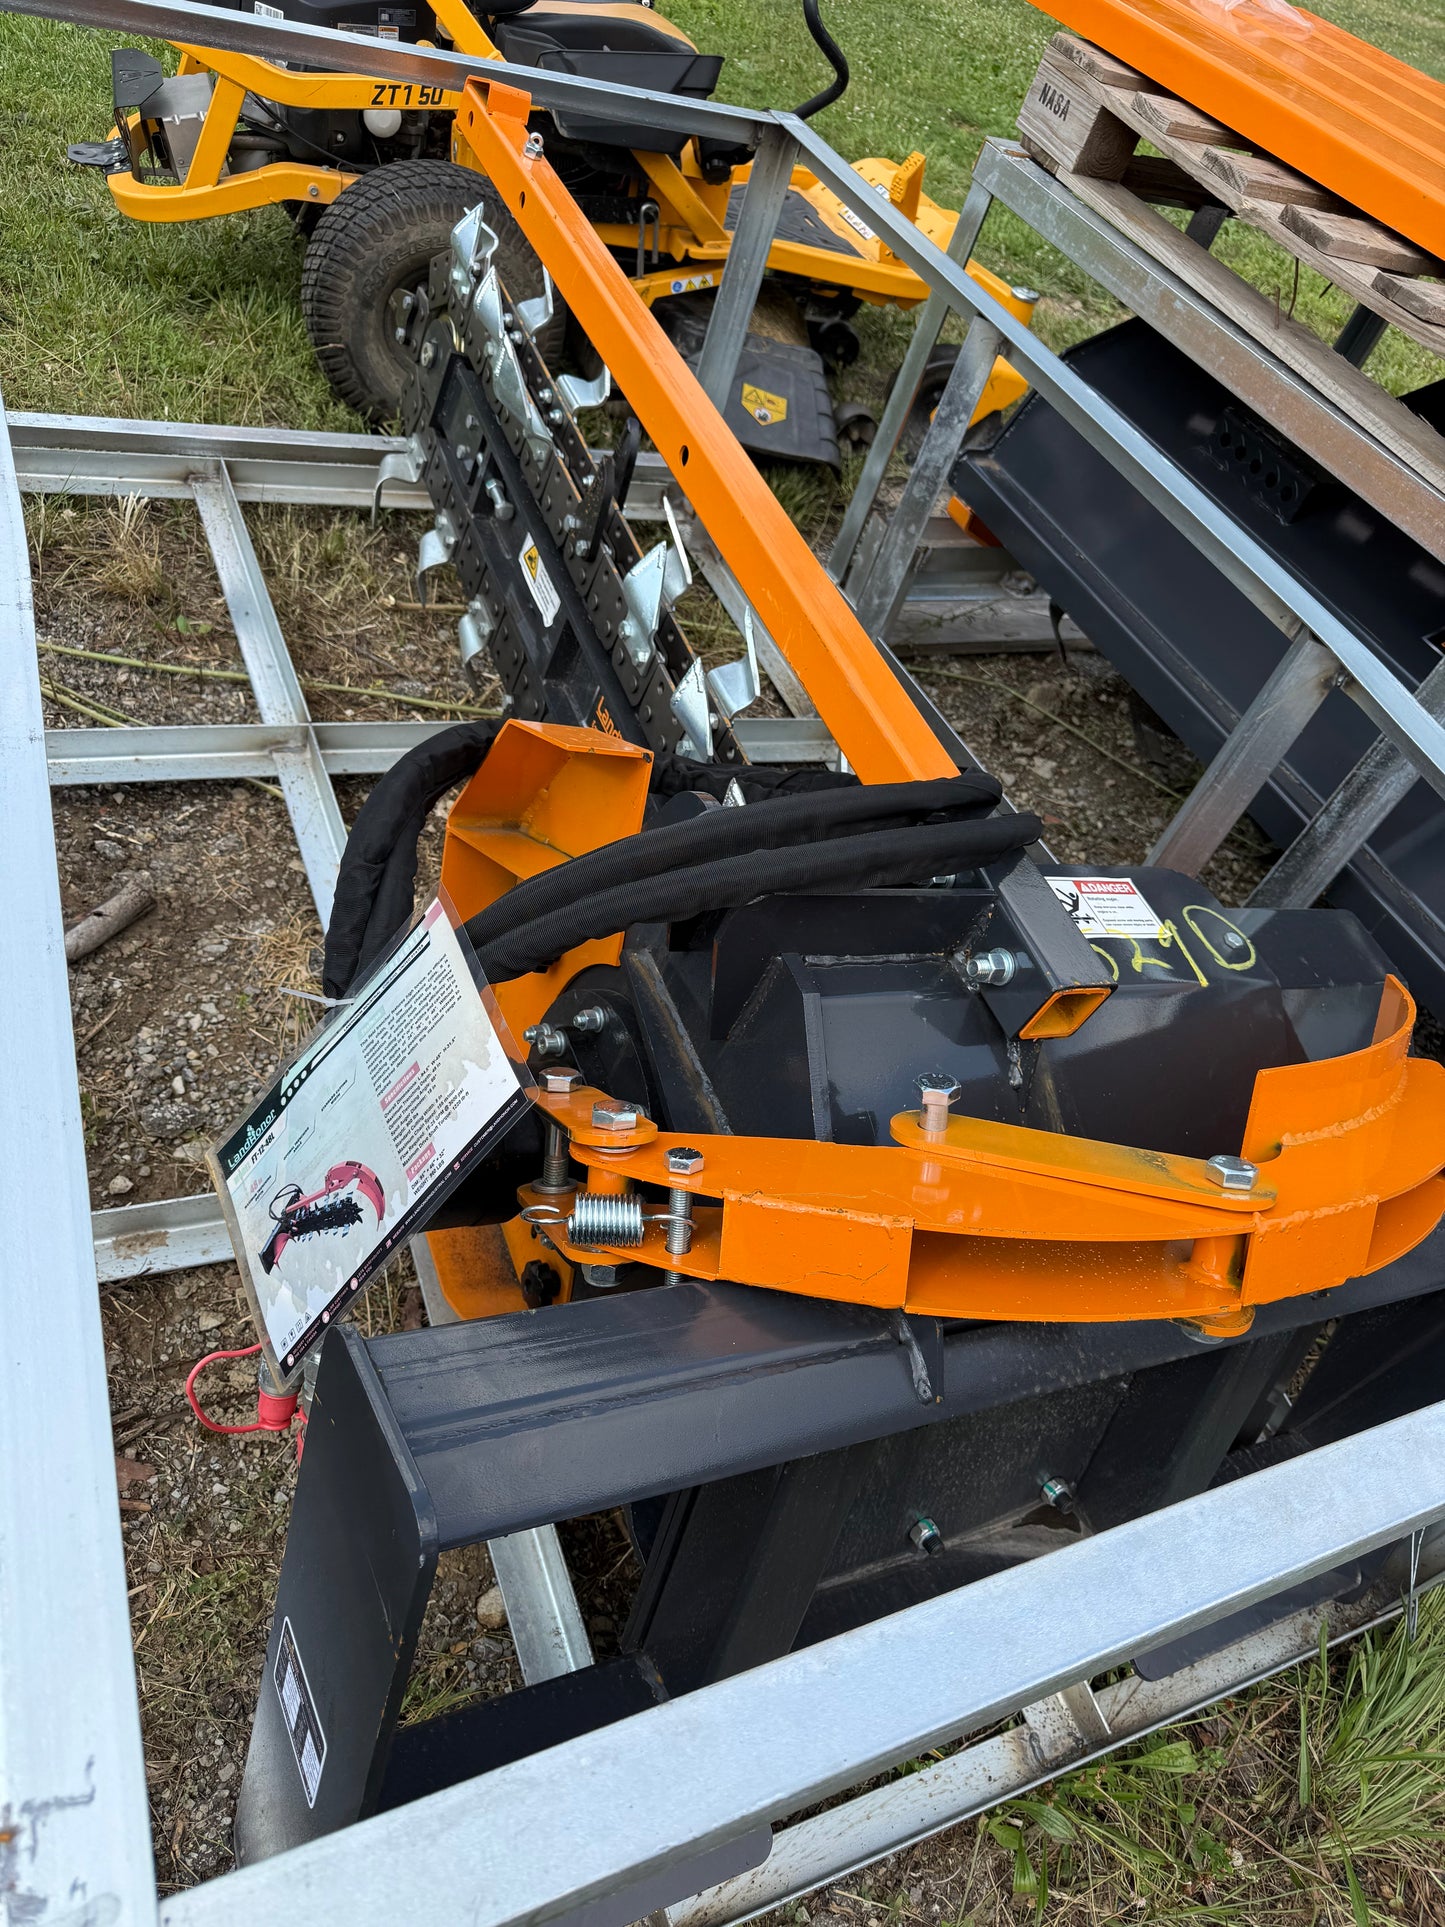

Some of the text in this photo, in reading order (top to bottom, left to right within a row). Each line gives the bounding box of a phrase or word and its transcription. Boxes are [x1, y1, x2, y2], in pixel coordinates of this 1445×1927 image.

[371, 84, 444, 105] ZT1 50
[1038, 82, 1072, 122] NASA
[362, 236, 452, 297] CARLISL
[1088, 883, 1133, 893] DANGER
[227, 1106, 276, 1169] LandHonor
[250, 1130, 275, 1164] FT-12-48L
[409, 1146, 431, 1176] Package
